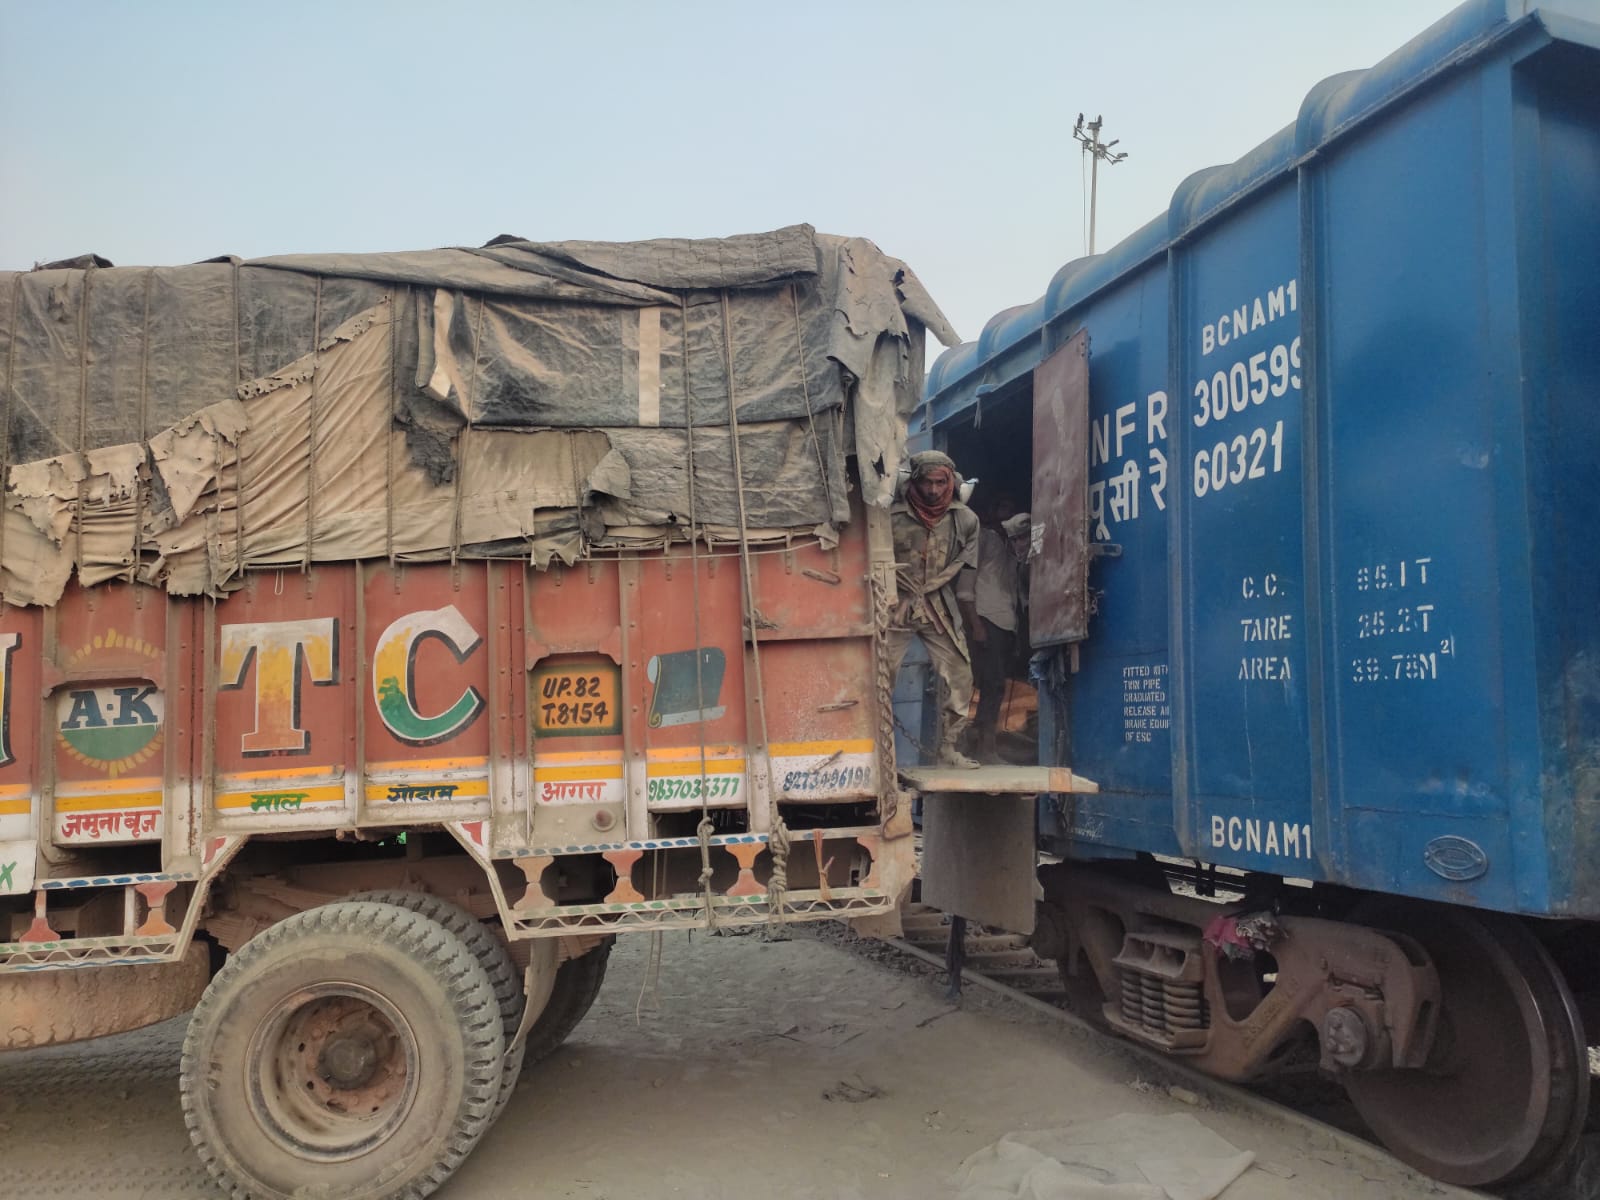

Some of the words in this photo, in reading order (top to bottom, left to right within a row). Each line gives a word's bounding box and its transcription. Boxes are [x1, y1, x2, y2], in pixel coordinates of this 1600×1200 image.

[1202, 279, 1298, 356] BCNAM1
[1194, 420, 1283, 497] 60321
[1241, 615, 1292, 642] TARE
[1123, 666, 1150, 678] FITTED
[1239, 657, 1291, 680] AREA
[543, 676, 600, 698] UP.82
[1143, 679, 1161, 690] PIPE
[1124, 692, 1166, 703] GRADUATED
[541, 701, 609, 726] T.8154
[1124, 706, 1157, 717] RELEASE
[1124, 719, 1148, 729] BRAKE
[1125, 731, 1135, 742] OF
[542, 782, 607, 801] आगरा
[250, 793, 310, 814] माल
[62, 812, 122, 839] जमुना
[1211, 815, 1311, 859] BCNAM1
